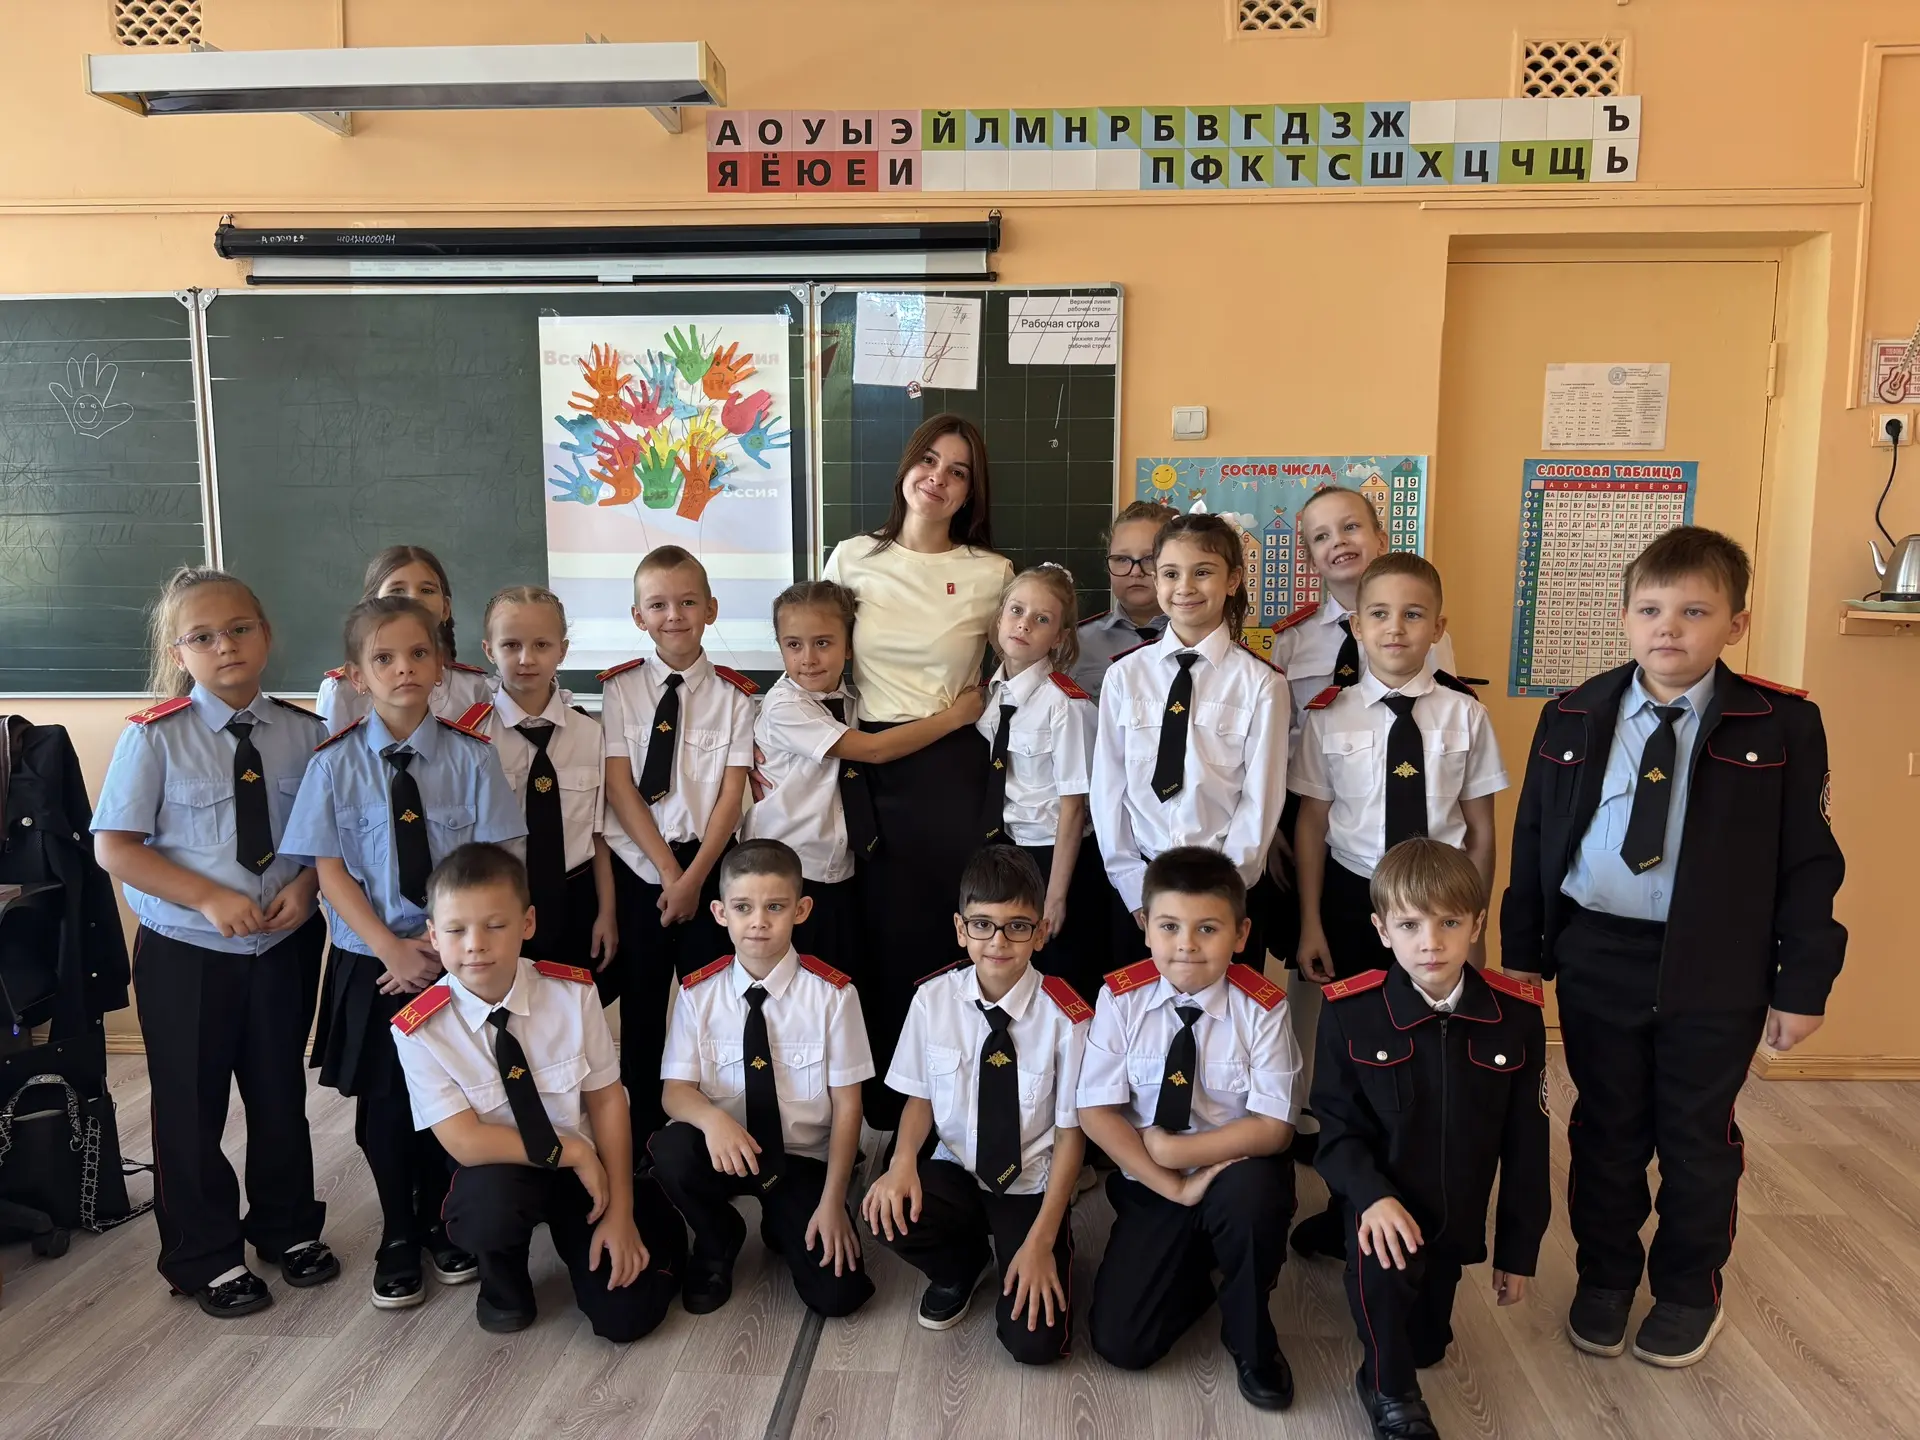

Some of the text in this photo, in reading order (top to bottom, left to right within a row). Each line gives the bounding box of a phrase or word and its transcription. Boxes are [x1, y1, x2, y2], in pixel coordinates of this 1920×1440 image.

[716, 106, 1629, 145] А О У Ы Э Й Л М Н Р Б В Г Д З Ж Ъ
[718, 147, 1628, 186] Я Ё Ю Е И П Ф К Т С Ш Х Ц Ч Щ Ь
[1022, 319, 1099, 330] Рабочая строка
[1221, 464, 1332, 476] СОСТАВ ЧИСЛА
[1537, 466, 1682, 479] СЛОГОВАЯ ТАБЛИЦА
[1371, 476, 1377, 485] 9
[1397, 478, 1416, 486] 1 9
[1378, 493, 1384, 501] 8
[1396, 493, 1415, 501] 2 8
[1378, 507, 1384, 515] 7
[1395, 507, 1415, 515] 3 7
[1395, 521, 1414, 529] 4 6
[1243, 534, 1249, 543] 5
[1281, 536, 1288, 544] 5
[1408, 535, 1414, 543] 5
[1281, 550, 1287, 558] 4
[1298, 550, 1305, 558] 3
[1249, 579, 1255, 587] 2
[1262, 635, 1272, 649] 5
[1114, 970, 1133, 989] КК
[1255, 984, 1276, 1002] КК
[1066, 1000, 1088, 1015] КК
[400, 1006, 422, 1025] КК
